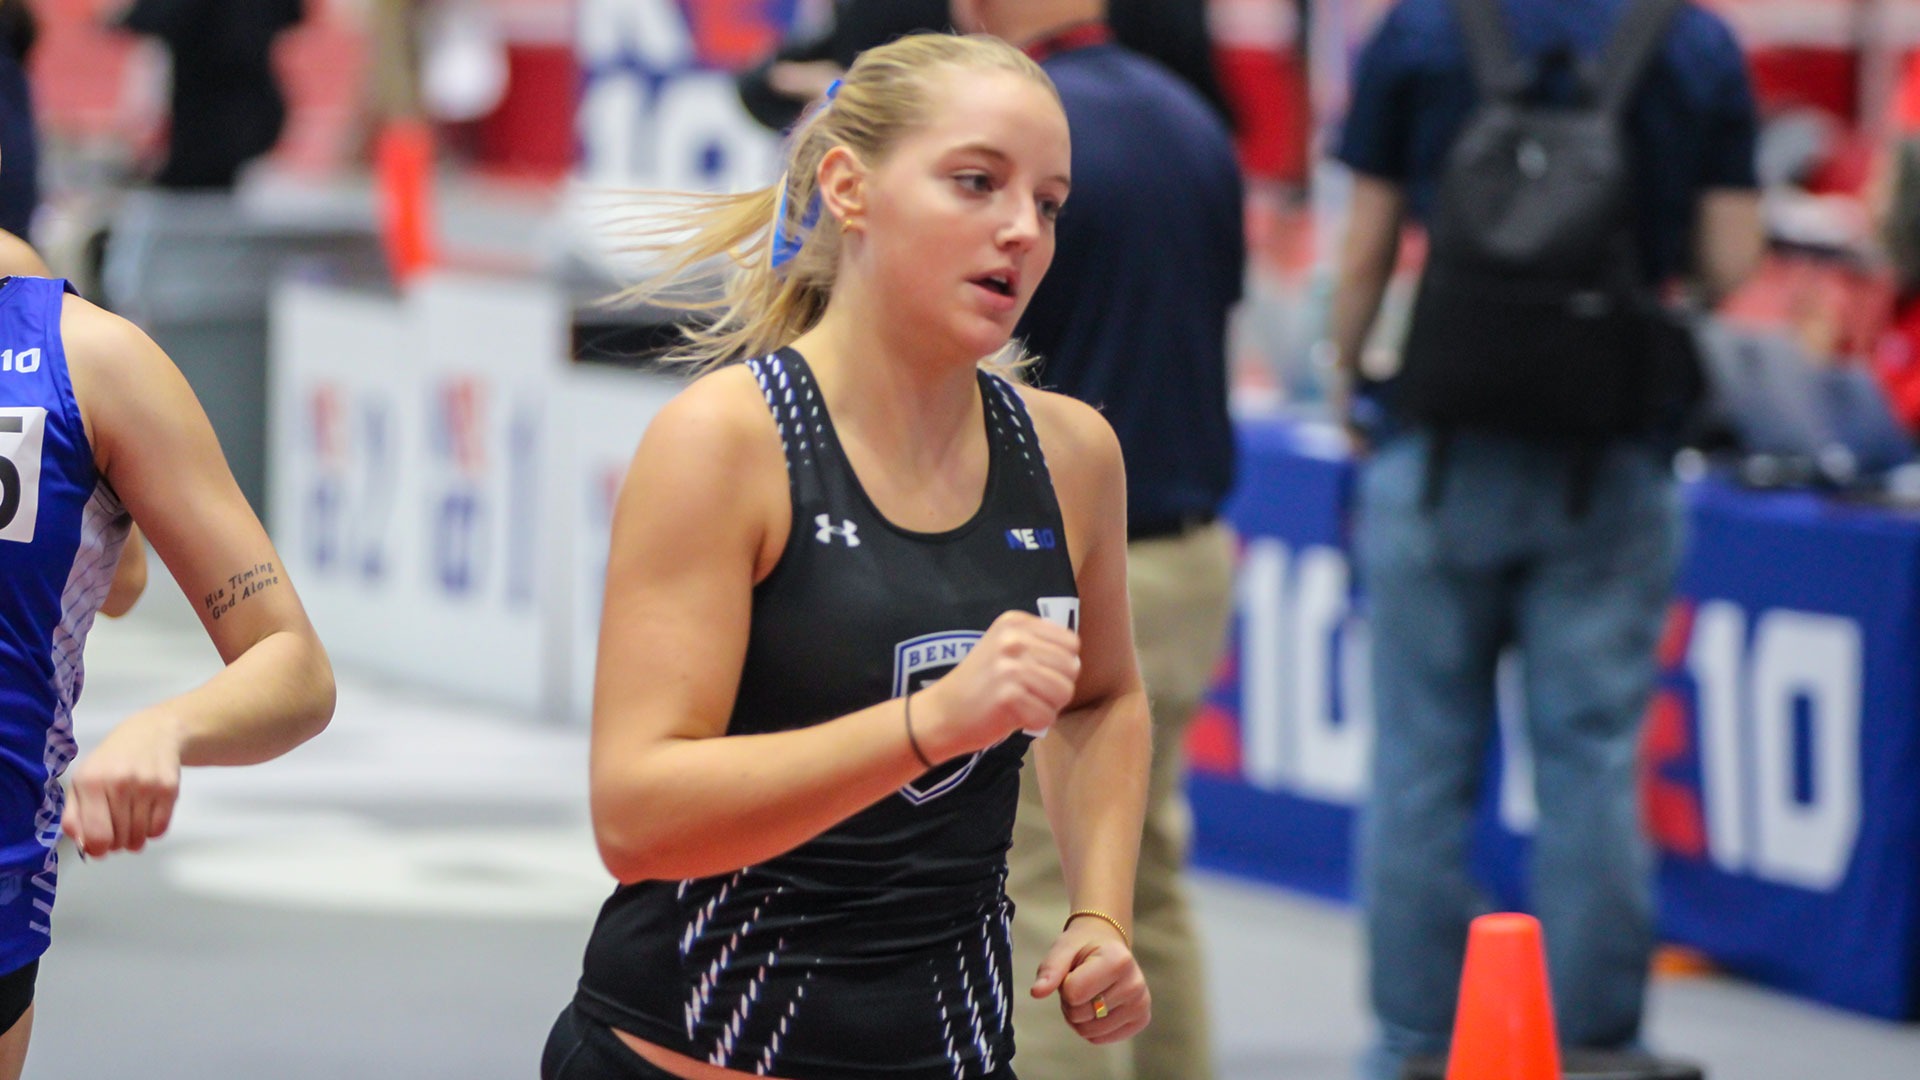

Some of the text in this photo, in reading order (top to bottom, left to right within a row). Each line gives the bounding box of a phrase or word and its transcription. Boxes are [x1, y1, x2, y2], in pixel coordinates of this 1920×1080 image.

[204, 562, 274, 608] His Timing
[212, 576, 278, 620] God Alone
[908, 643, 975, 668] BENT
